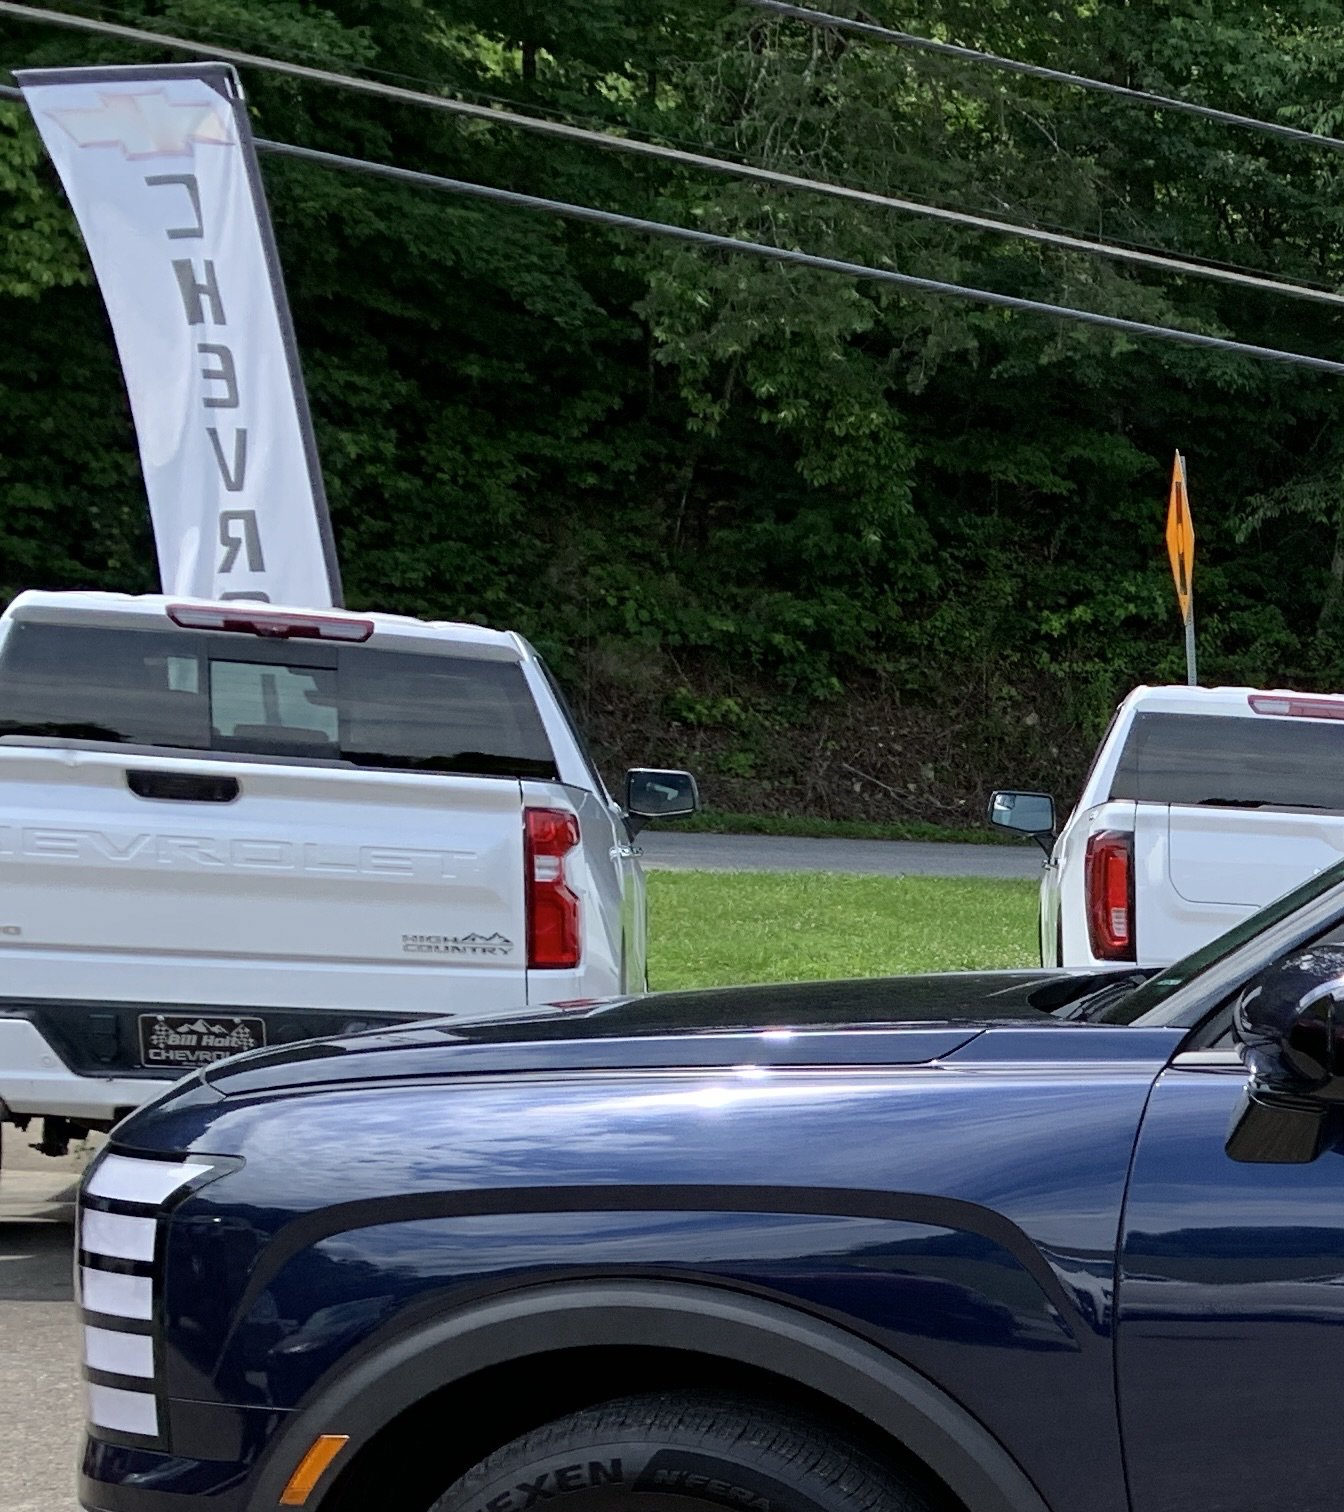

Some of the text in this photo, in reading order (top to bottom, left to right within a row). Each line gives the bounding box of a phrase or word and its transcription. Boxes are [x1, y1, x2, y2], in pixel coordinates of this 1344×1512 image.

[0, 824, 478, 878] EVROLET
[402, 933, 459, 944] HIGH
[402, 944, 510, 955] COUNTRY
[167, 1034, 238, 1047] Bill Holt
